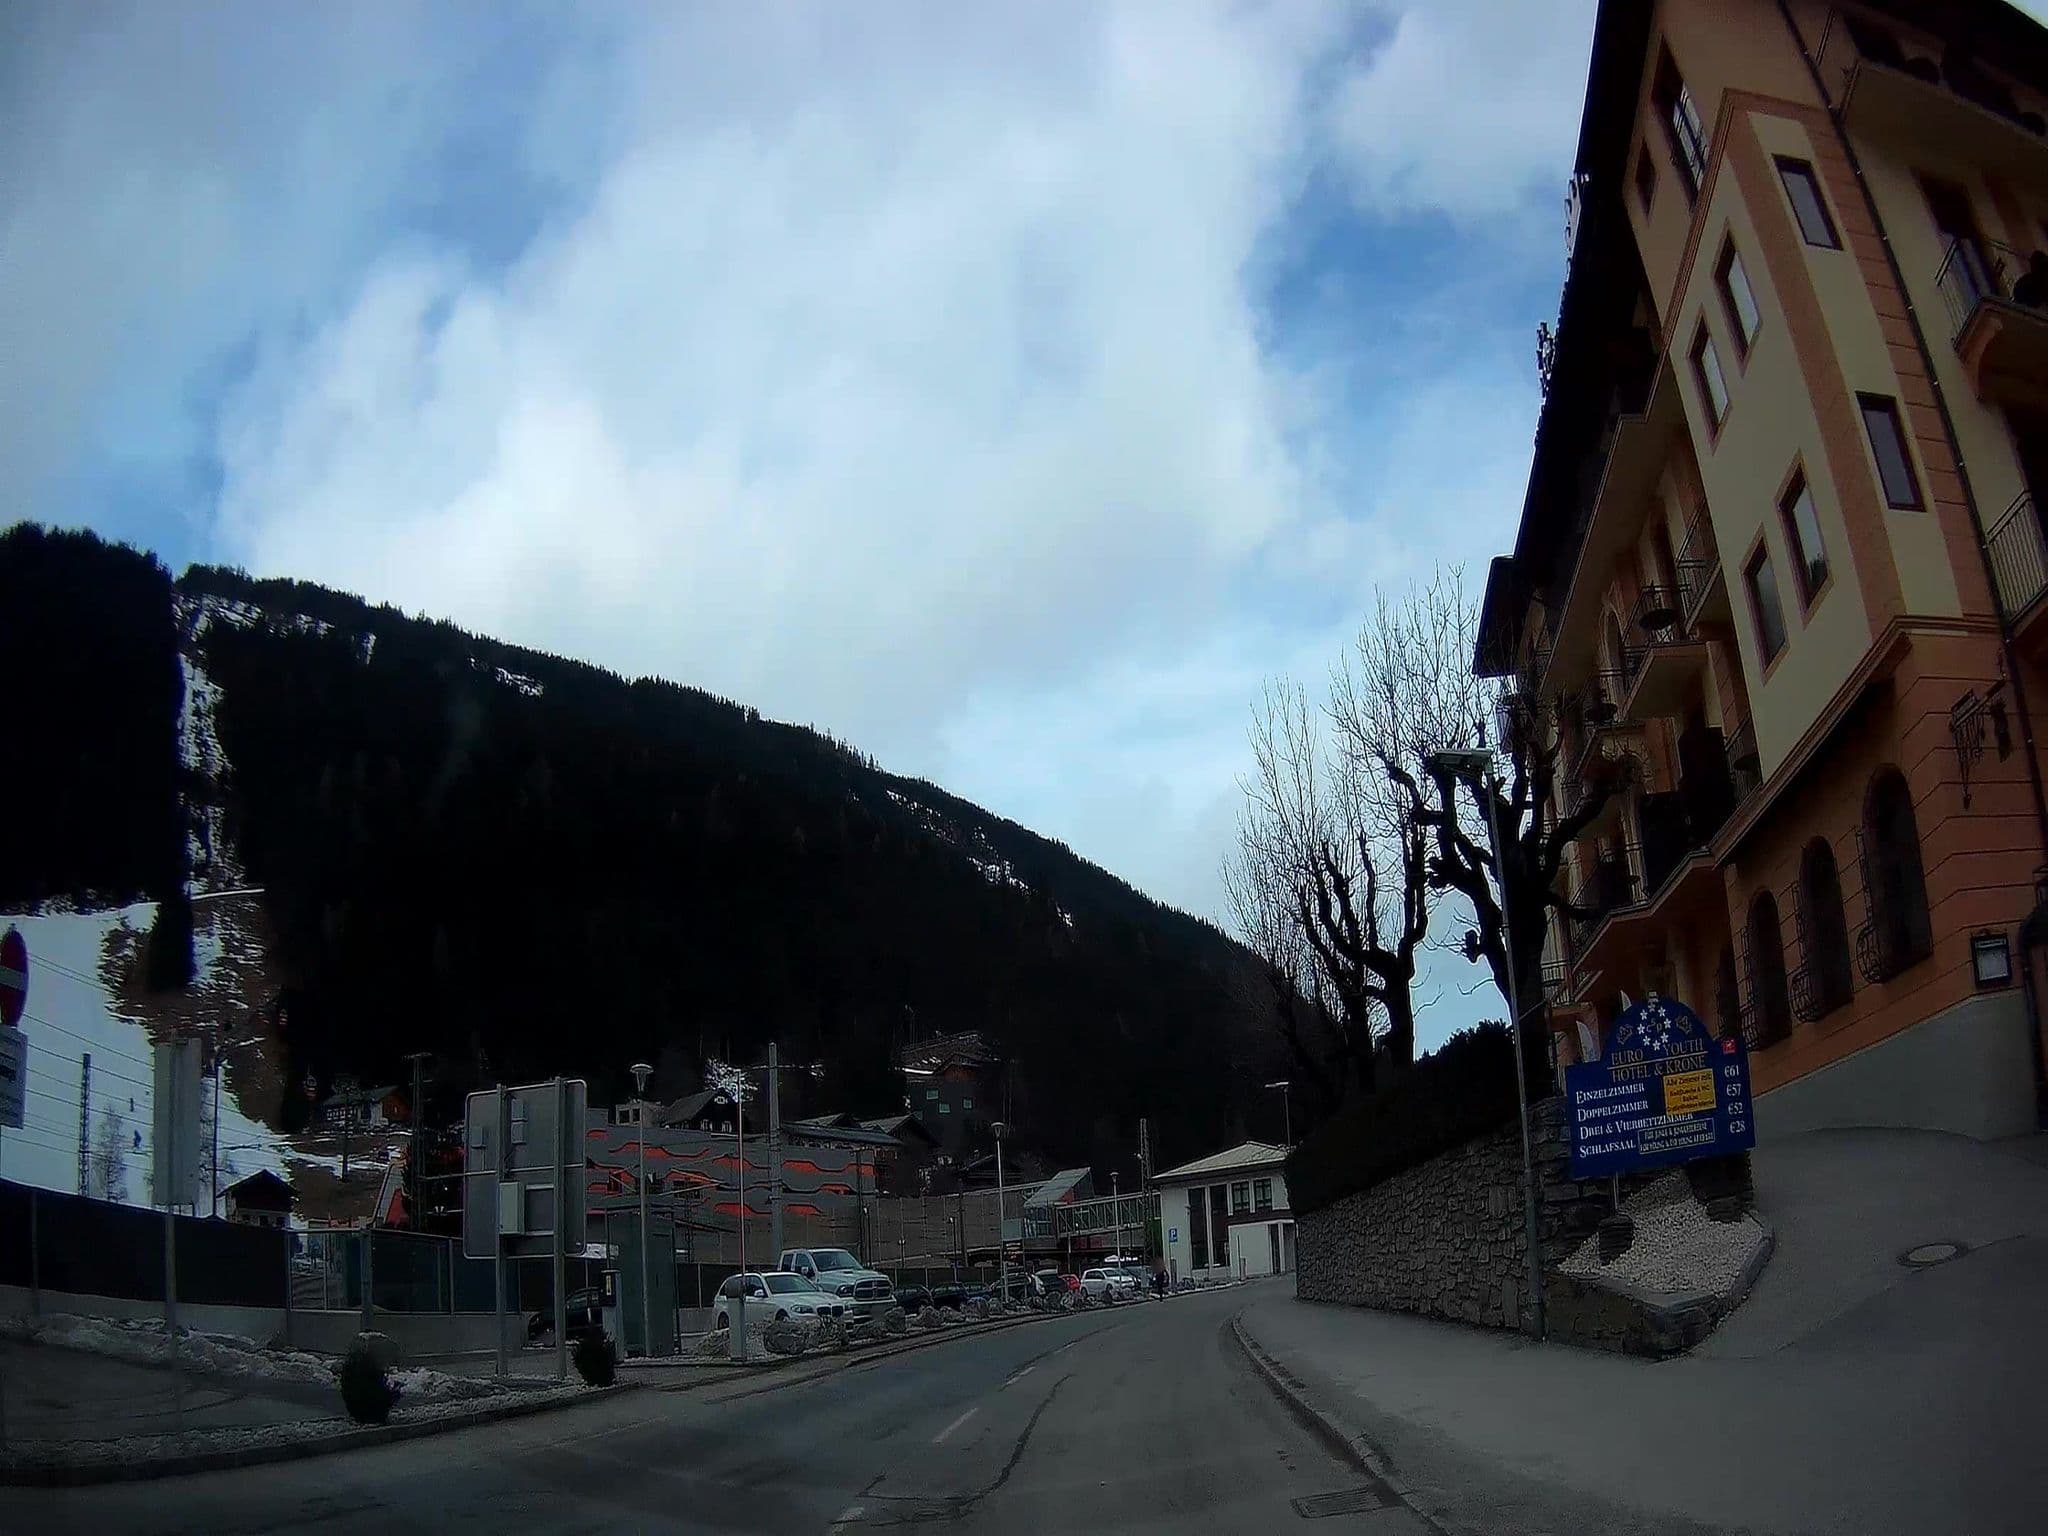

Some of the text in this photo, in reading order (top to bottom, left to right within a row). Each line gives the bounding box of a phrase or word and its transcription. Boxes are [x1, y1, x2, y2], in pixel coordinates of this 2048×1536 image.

[1611, 1038, 1704, 1066] EURO YOUTH
[1611, 1055, 1706, 1083] HOTEL & KRONE
[1724, 1064, 1740, 1078] €61
[1576, 1082, 1646, 1105] EINZELZIMMER
[1726, 1083, 1742, 1097] €57
[1577, 1100, 1649, 1122] DOPPELZIMMER
[1728, 1102, 1744, 1116] €52
[1580, 1125, 1604, 1140] DREI
[1605, 1121, 1614, 1134] &
[1729, 1120, 1746, 1134] €28
[1580, 1139, 1637, 1159] SCHLAFSAAL
